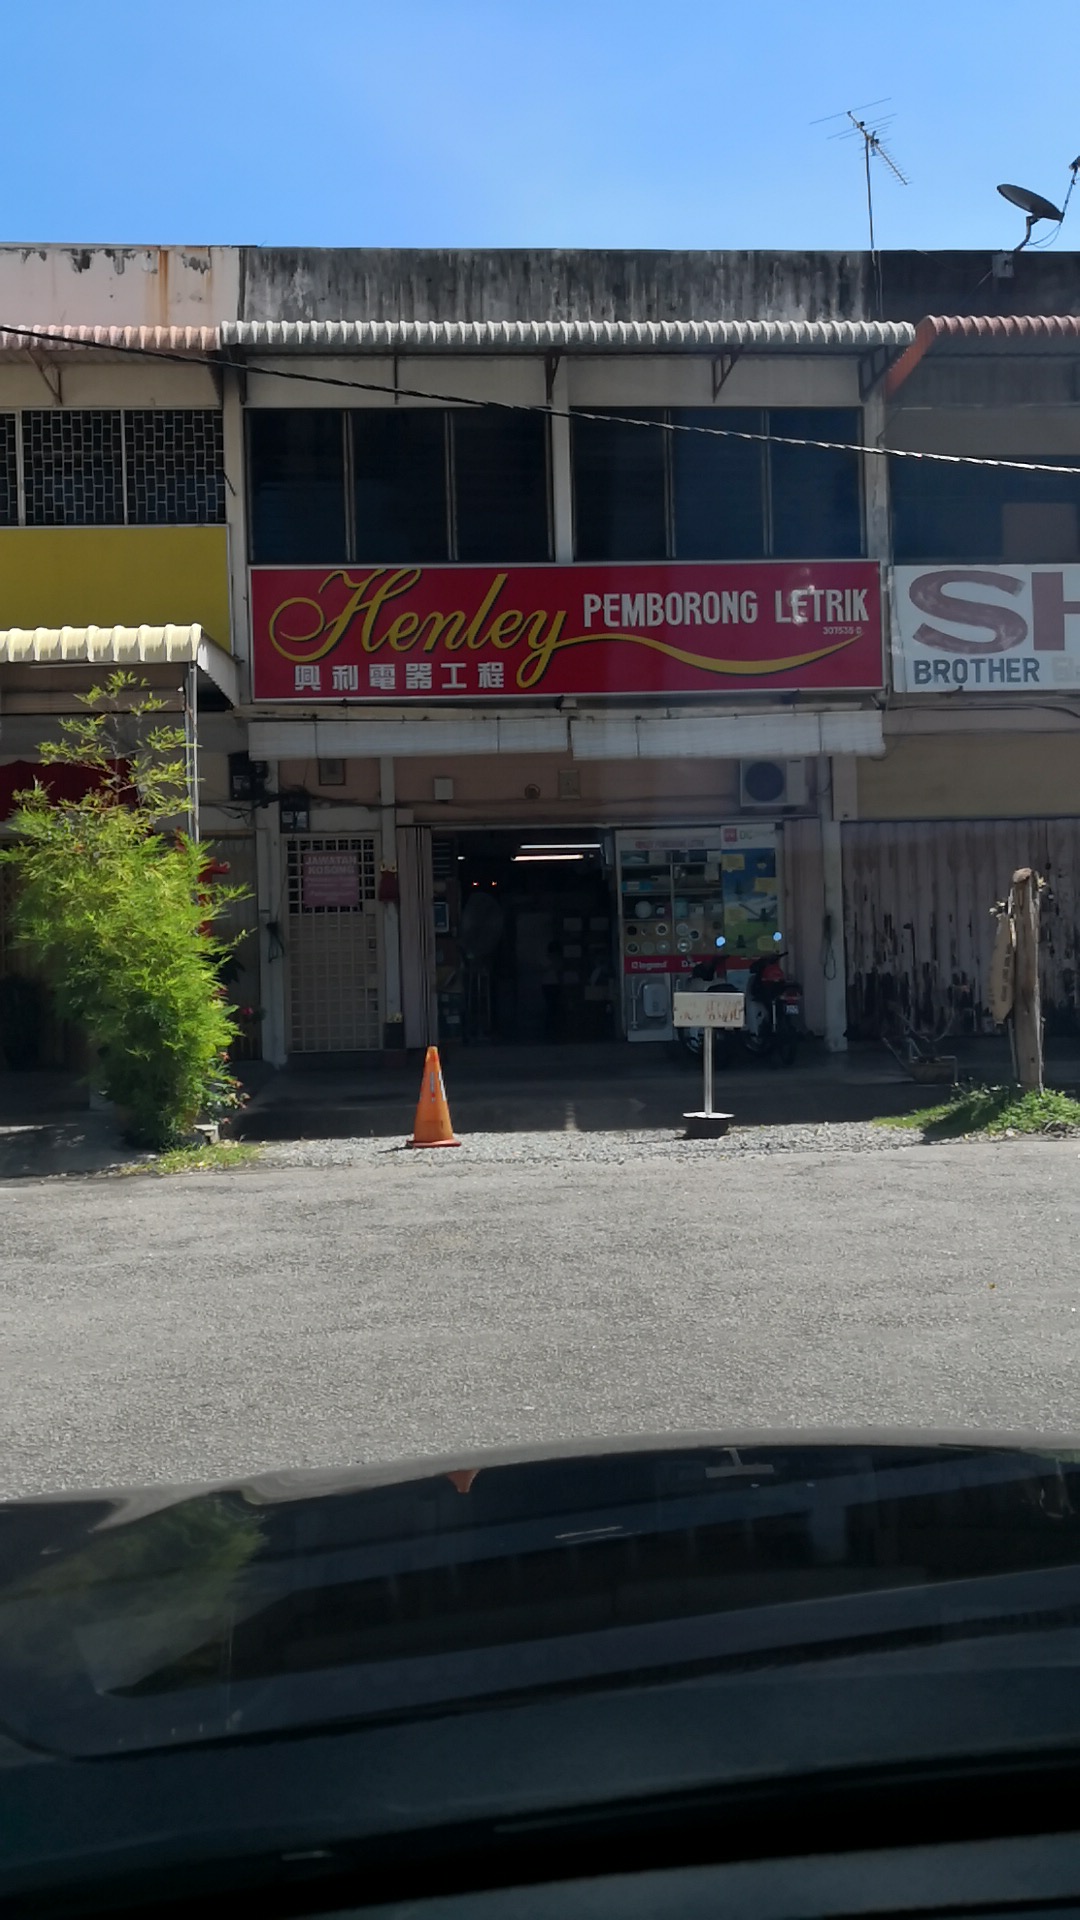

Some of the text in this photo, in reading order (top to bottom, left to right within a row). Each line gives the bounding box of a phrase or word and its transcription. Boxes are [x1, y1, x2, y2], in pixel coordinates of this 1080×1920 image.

[583, 590, 870, 628] PEMBORONG LETRIK
[269, 568, 566, 689] Henley
[294, 661, 505, 691] 興利電器工程
[913, 657, 1040, 685] BROTHER
